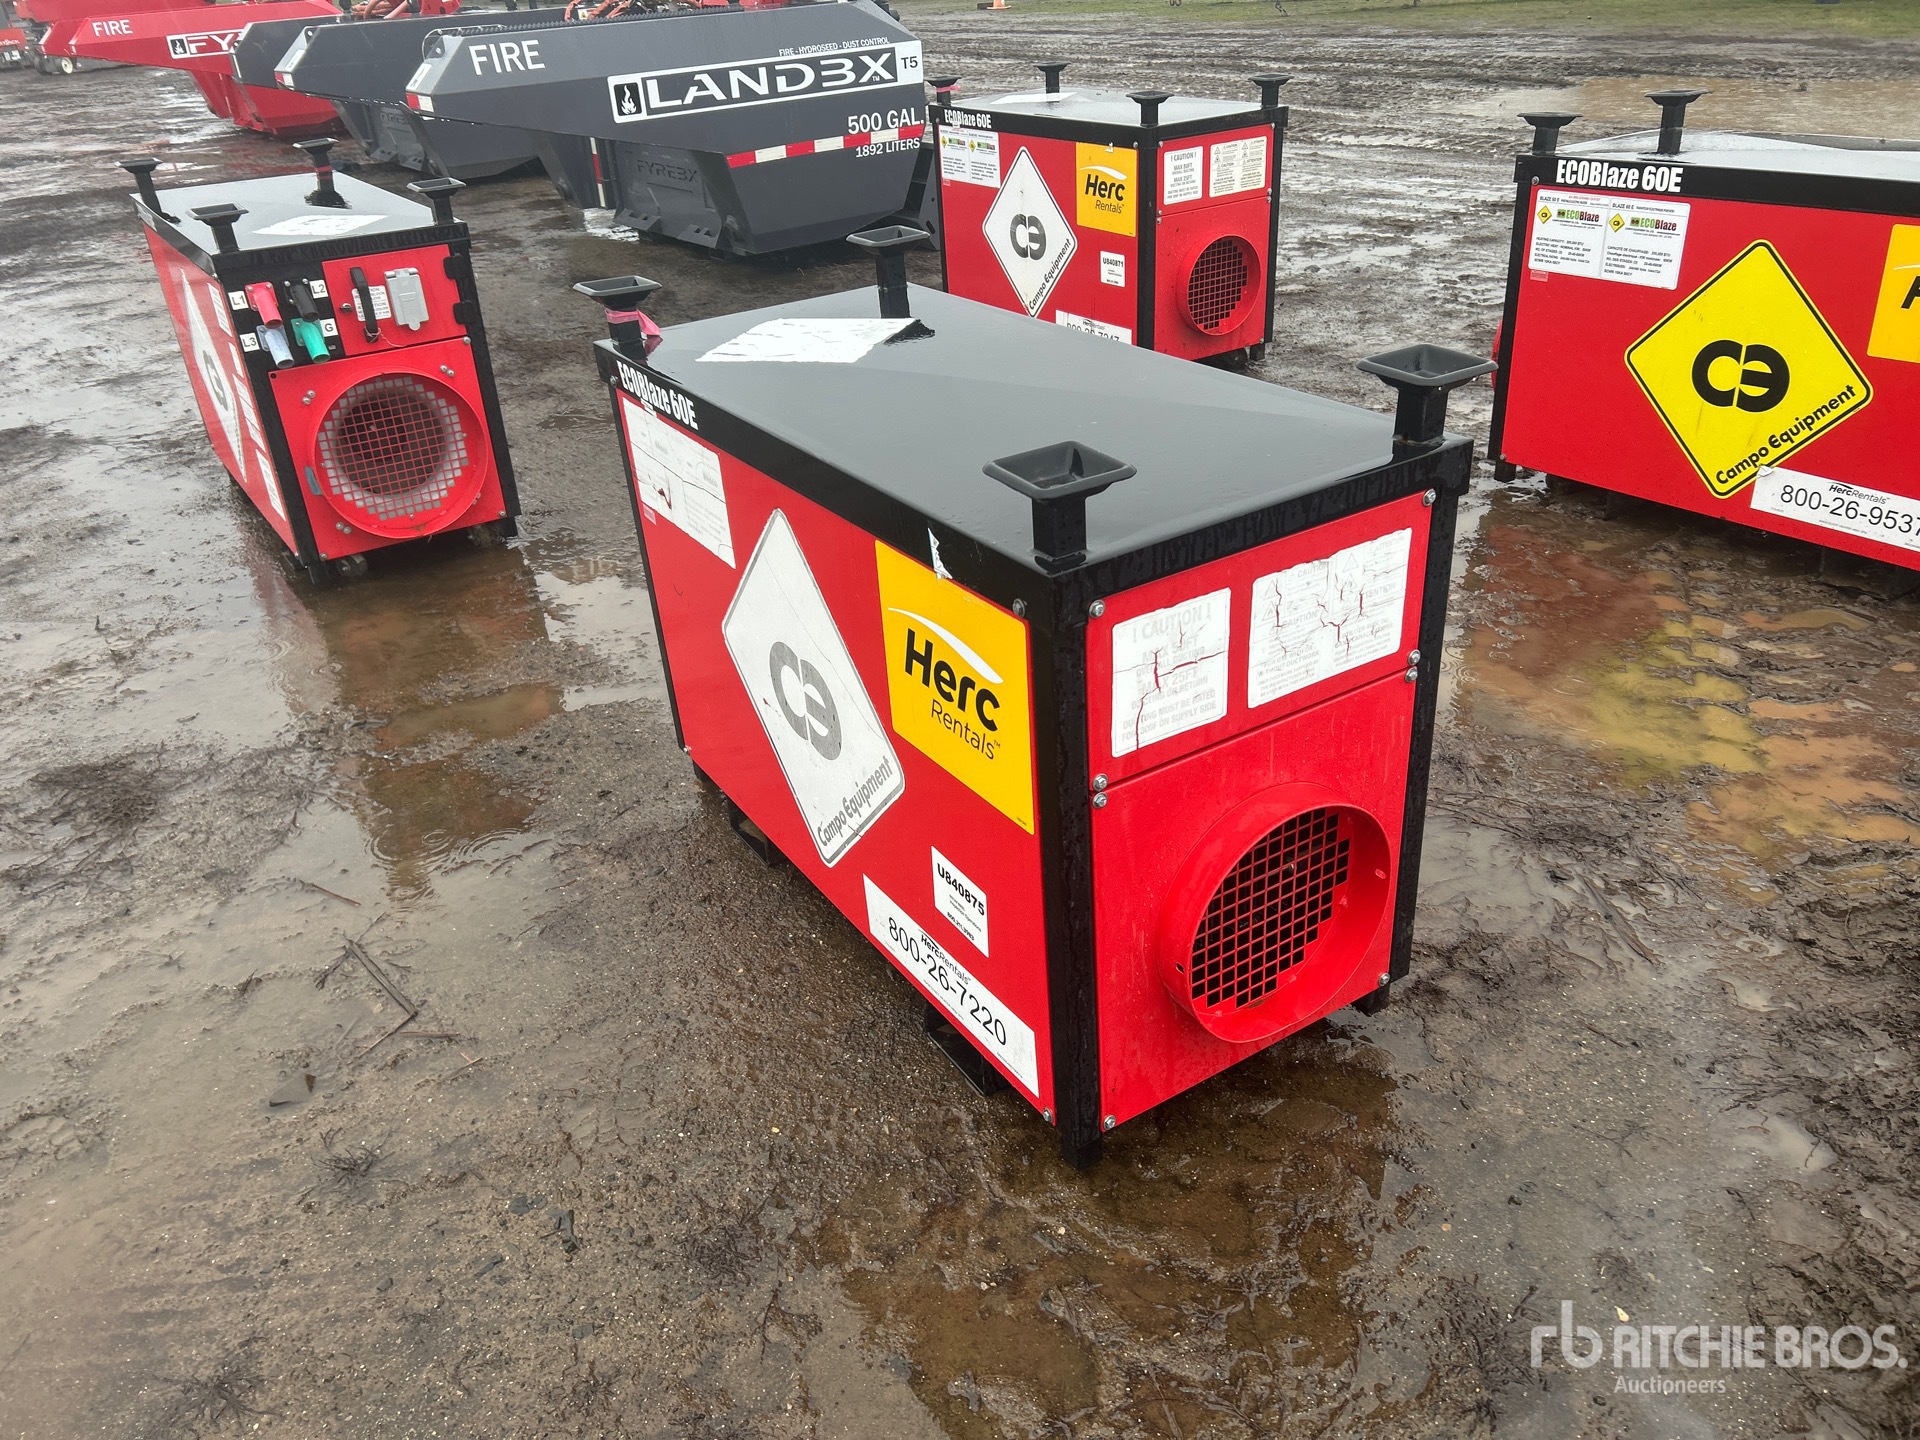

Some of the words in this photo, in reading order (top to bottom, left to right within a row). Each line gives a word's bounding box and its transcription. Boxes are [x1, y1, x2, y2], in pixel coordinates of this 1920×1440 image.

[92, 19, 133, 37] FIRE
[188, 33, 238, 54] FY
[779, 47, 794, 57] FIRE
[798, 43, 838, 55] HYDROSEED
[842, 39, 860, 48] DUST
[860, 37, 890, 47] CONTROL
[468, 39, 546, 76] FIRE
[901, 56, 918, 69] T5
[847, 112, 882, 135] 500
[886, 107, 924, 129] GAL.
[944, 108, 975, 126] ECOBlaze
[976, 113, 992, 129] 60E
[855, 143, 883, 158] 1892
[885, 138, 920, 153] LITERS
[1174, 152, 1194, 162] CAUTION
[1555, 159, 1639, 189] ECOBlaze
[1641, 165, 1684, 193] 60E
[1085, 173, 1125, 202] Herc
[1095, 199, 1123, 214] Rentals
[1566, 209, 1599, 222] ECOBlaze
[1640, 217, 1677, 231] ECOBlaze
[1029, 282, 1046, 310] Campo
[1043, 238, 1071, 284] Equipment
[311, 283, 326, 294] L2
[231, 295, 246, 306] L1
[324, 323, 334, 332] G
[243, 337, 257, 348] L3
[616, 360, 671, 414] ECOBlaze
[669, 389, 699, 430] 60E
[1716, 446, 1769, 485] Campo
[1768, 384, 1857, 449] Equipment
[1781, 484, 1920, 537] 800-26-953
[1141, 607, 1203, 640] CAUTION
[905, 627, 1001, 732] Herc
[1142, 677, 1170, 695] MX
[1172, 666, 1198, 686] 25FT
[1158, 703, 1179, 719] MUST
[1181, 699, 1191, 710] BE
[1171, 706, 1198, 724] SUPPLY
[1200, 701, 1218, 715] SIDE
[817, 810, 847, 847] Campo
[842, 755, 894, 819] Equipment
[937, 862, 984, 916] U840875
[889, 916, 1007, 1046] 800-26-7220
